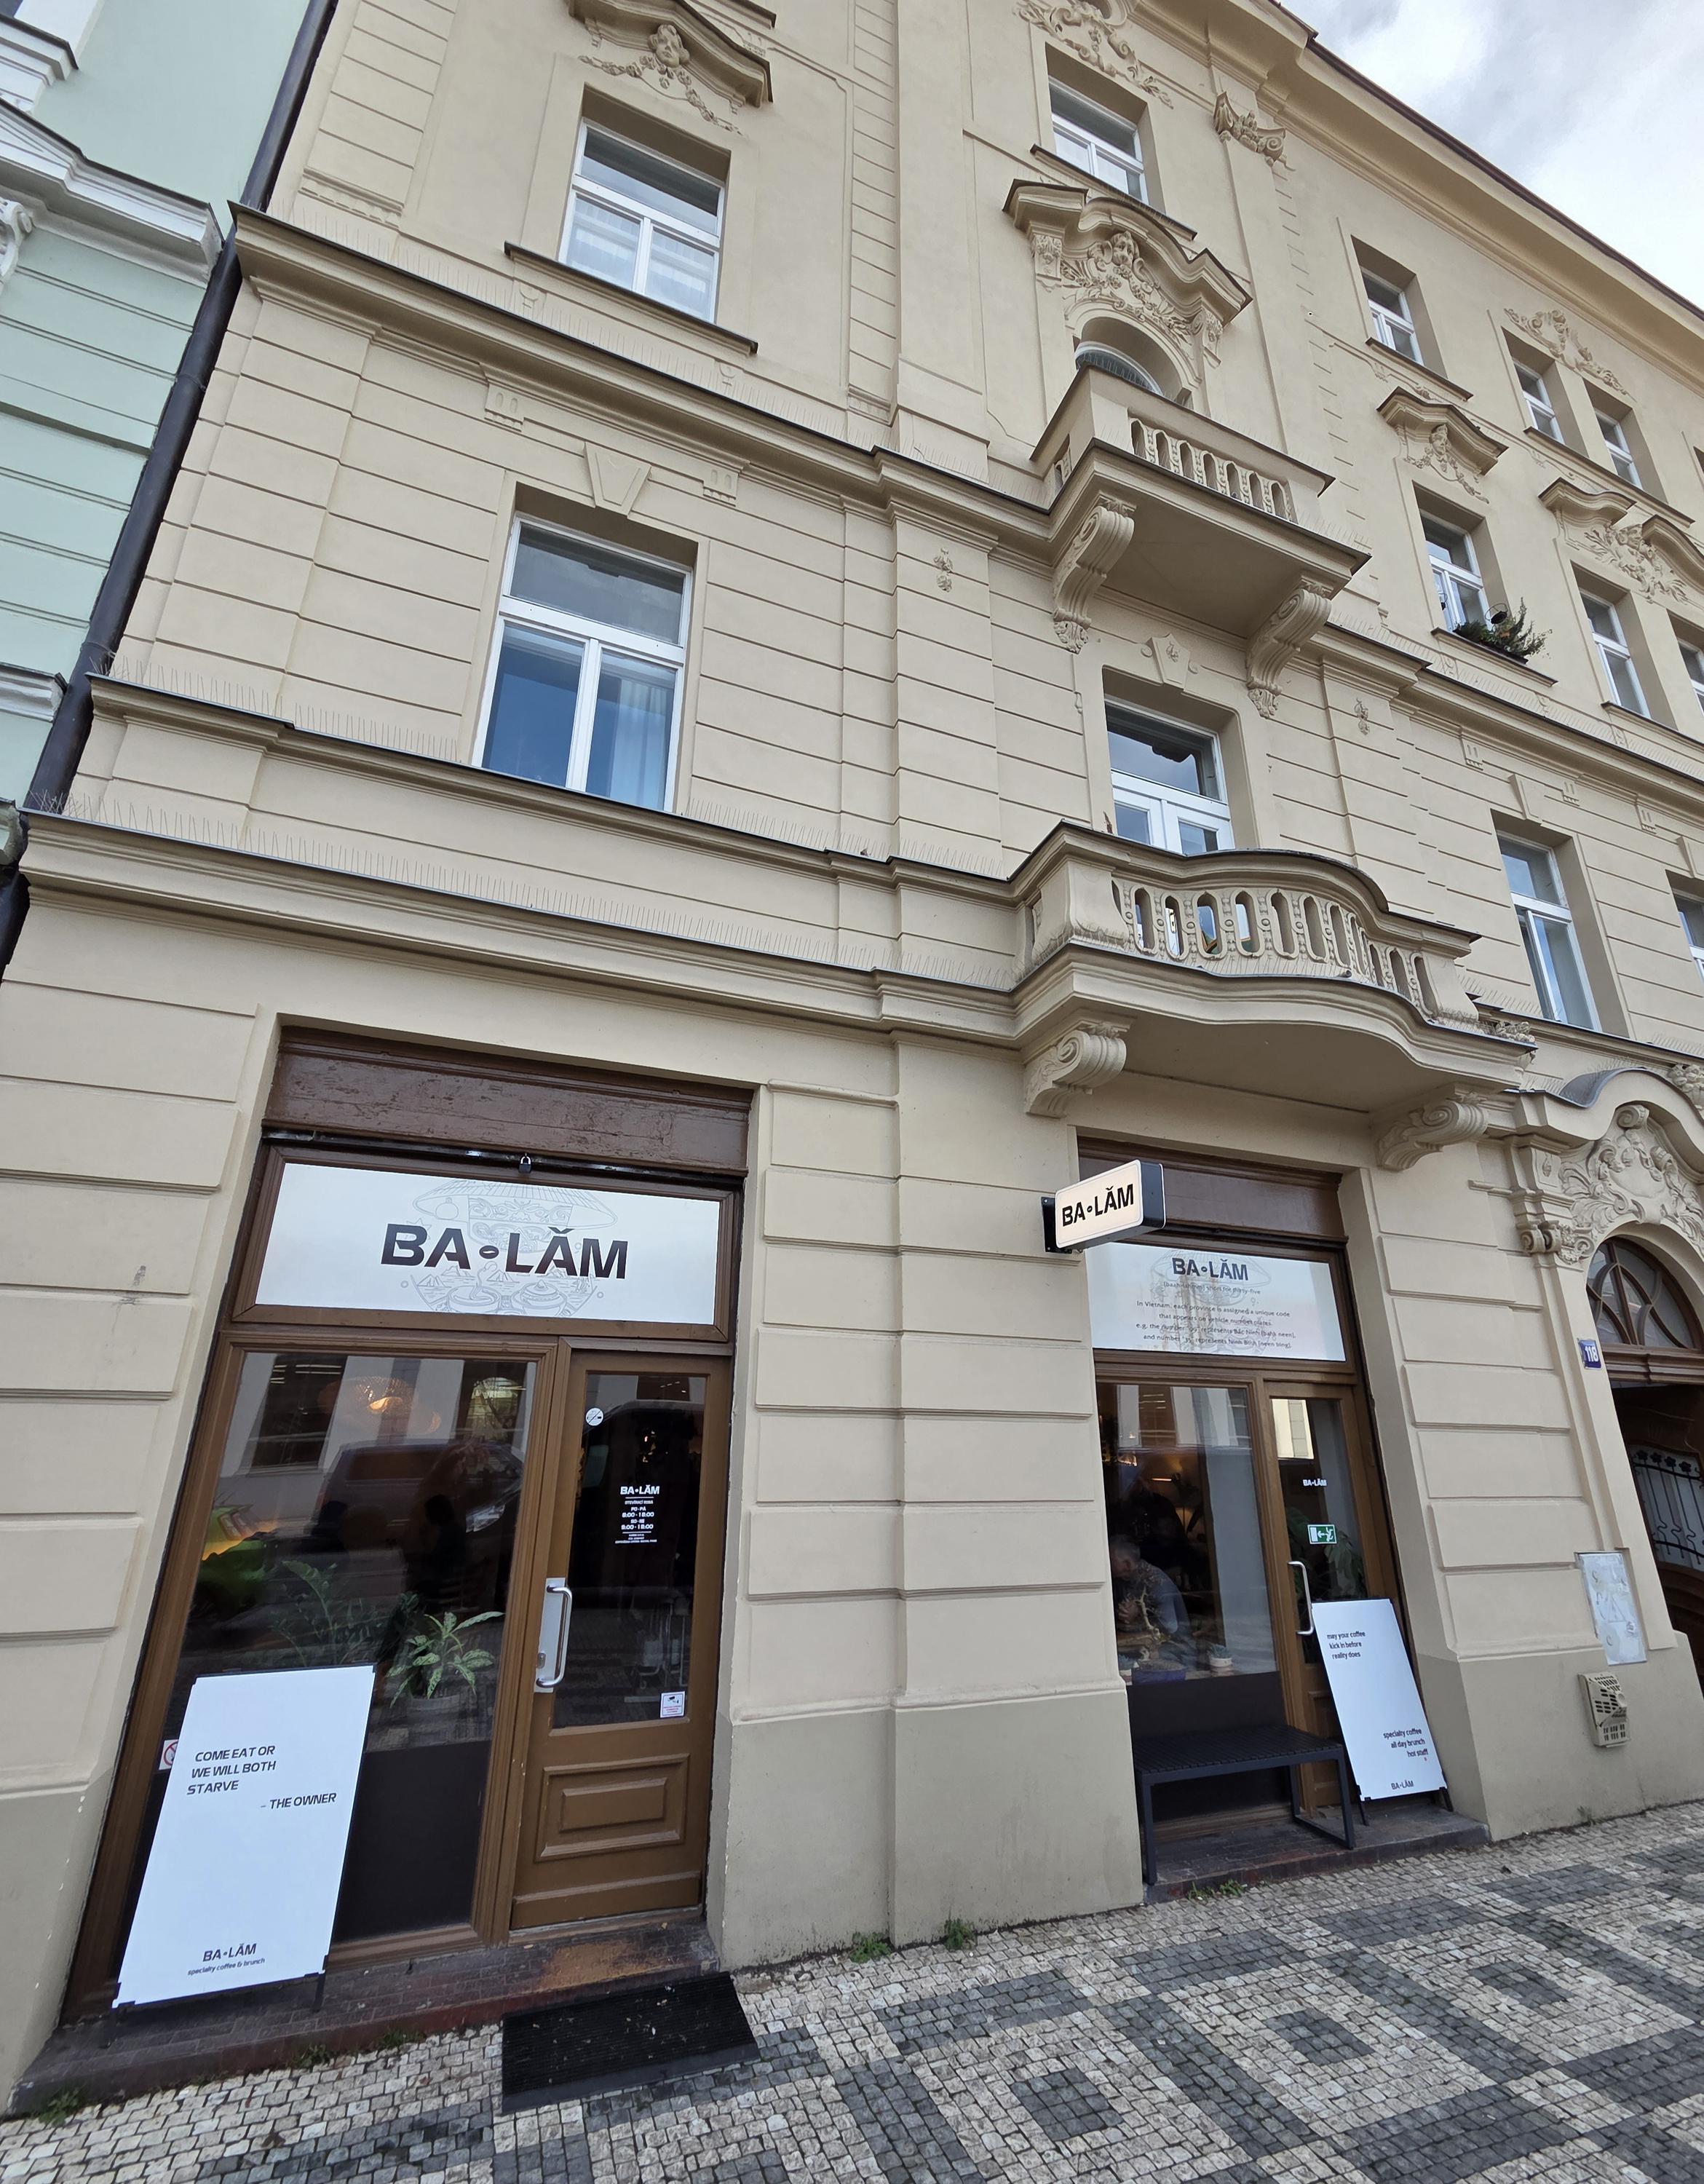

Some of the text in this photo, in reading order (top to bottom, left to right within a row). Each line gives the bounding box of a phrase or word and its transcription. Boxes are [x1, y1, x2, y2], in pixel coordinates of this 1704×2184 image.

[1585, 1345, 1599, 1362] 118
[1332, 1652, 1347, 1660] reality
[1383, 1728, 1422, 1740] specialty coffee
[1398, 1741, 1407, 1749] day
[1407, 1738, 1426, 1746] brunch
[195, 1745, 276, 1762] COME EAT OR
[1416, 1748, 1429, 1757] stuff
[191, 1760, 277, 1779] WE WILL BOTH
[186, 1780, 239, 1795] STARVE
[269, 1796, 293, 1809] THE
[293, 1792, 337, 1807] OWNER
[187, 1966, 216, 1976] specialty
[216, 1962, 237, 1971] coffee
[243, 1957, 266, 1967] brunch
